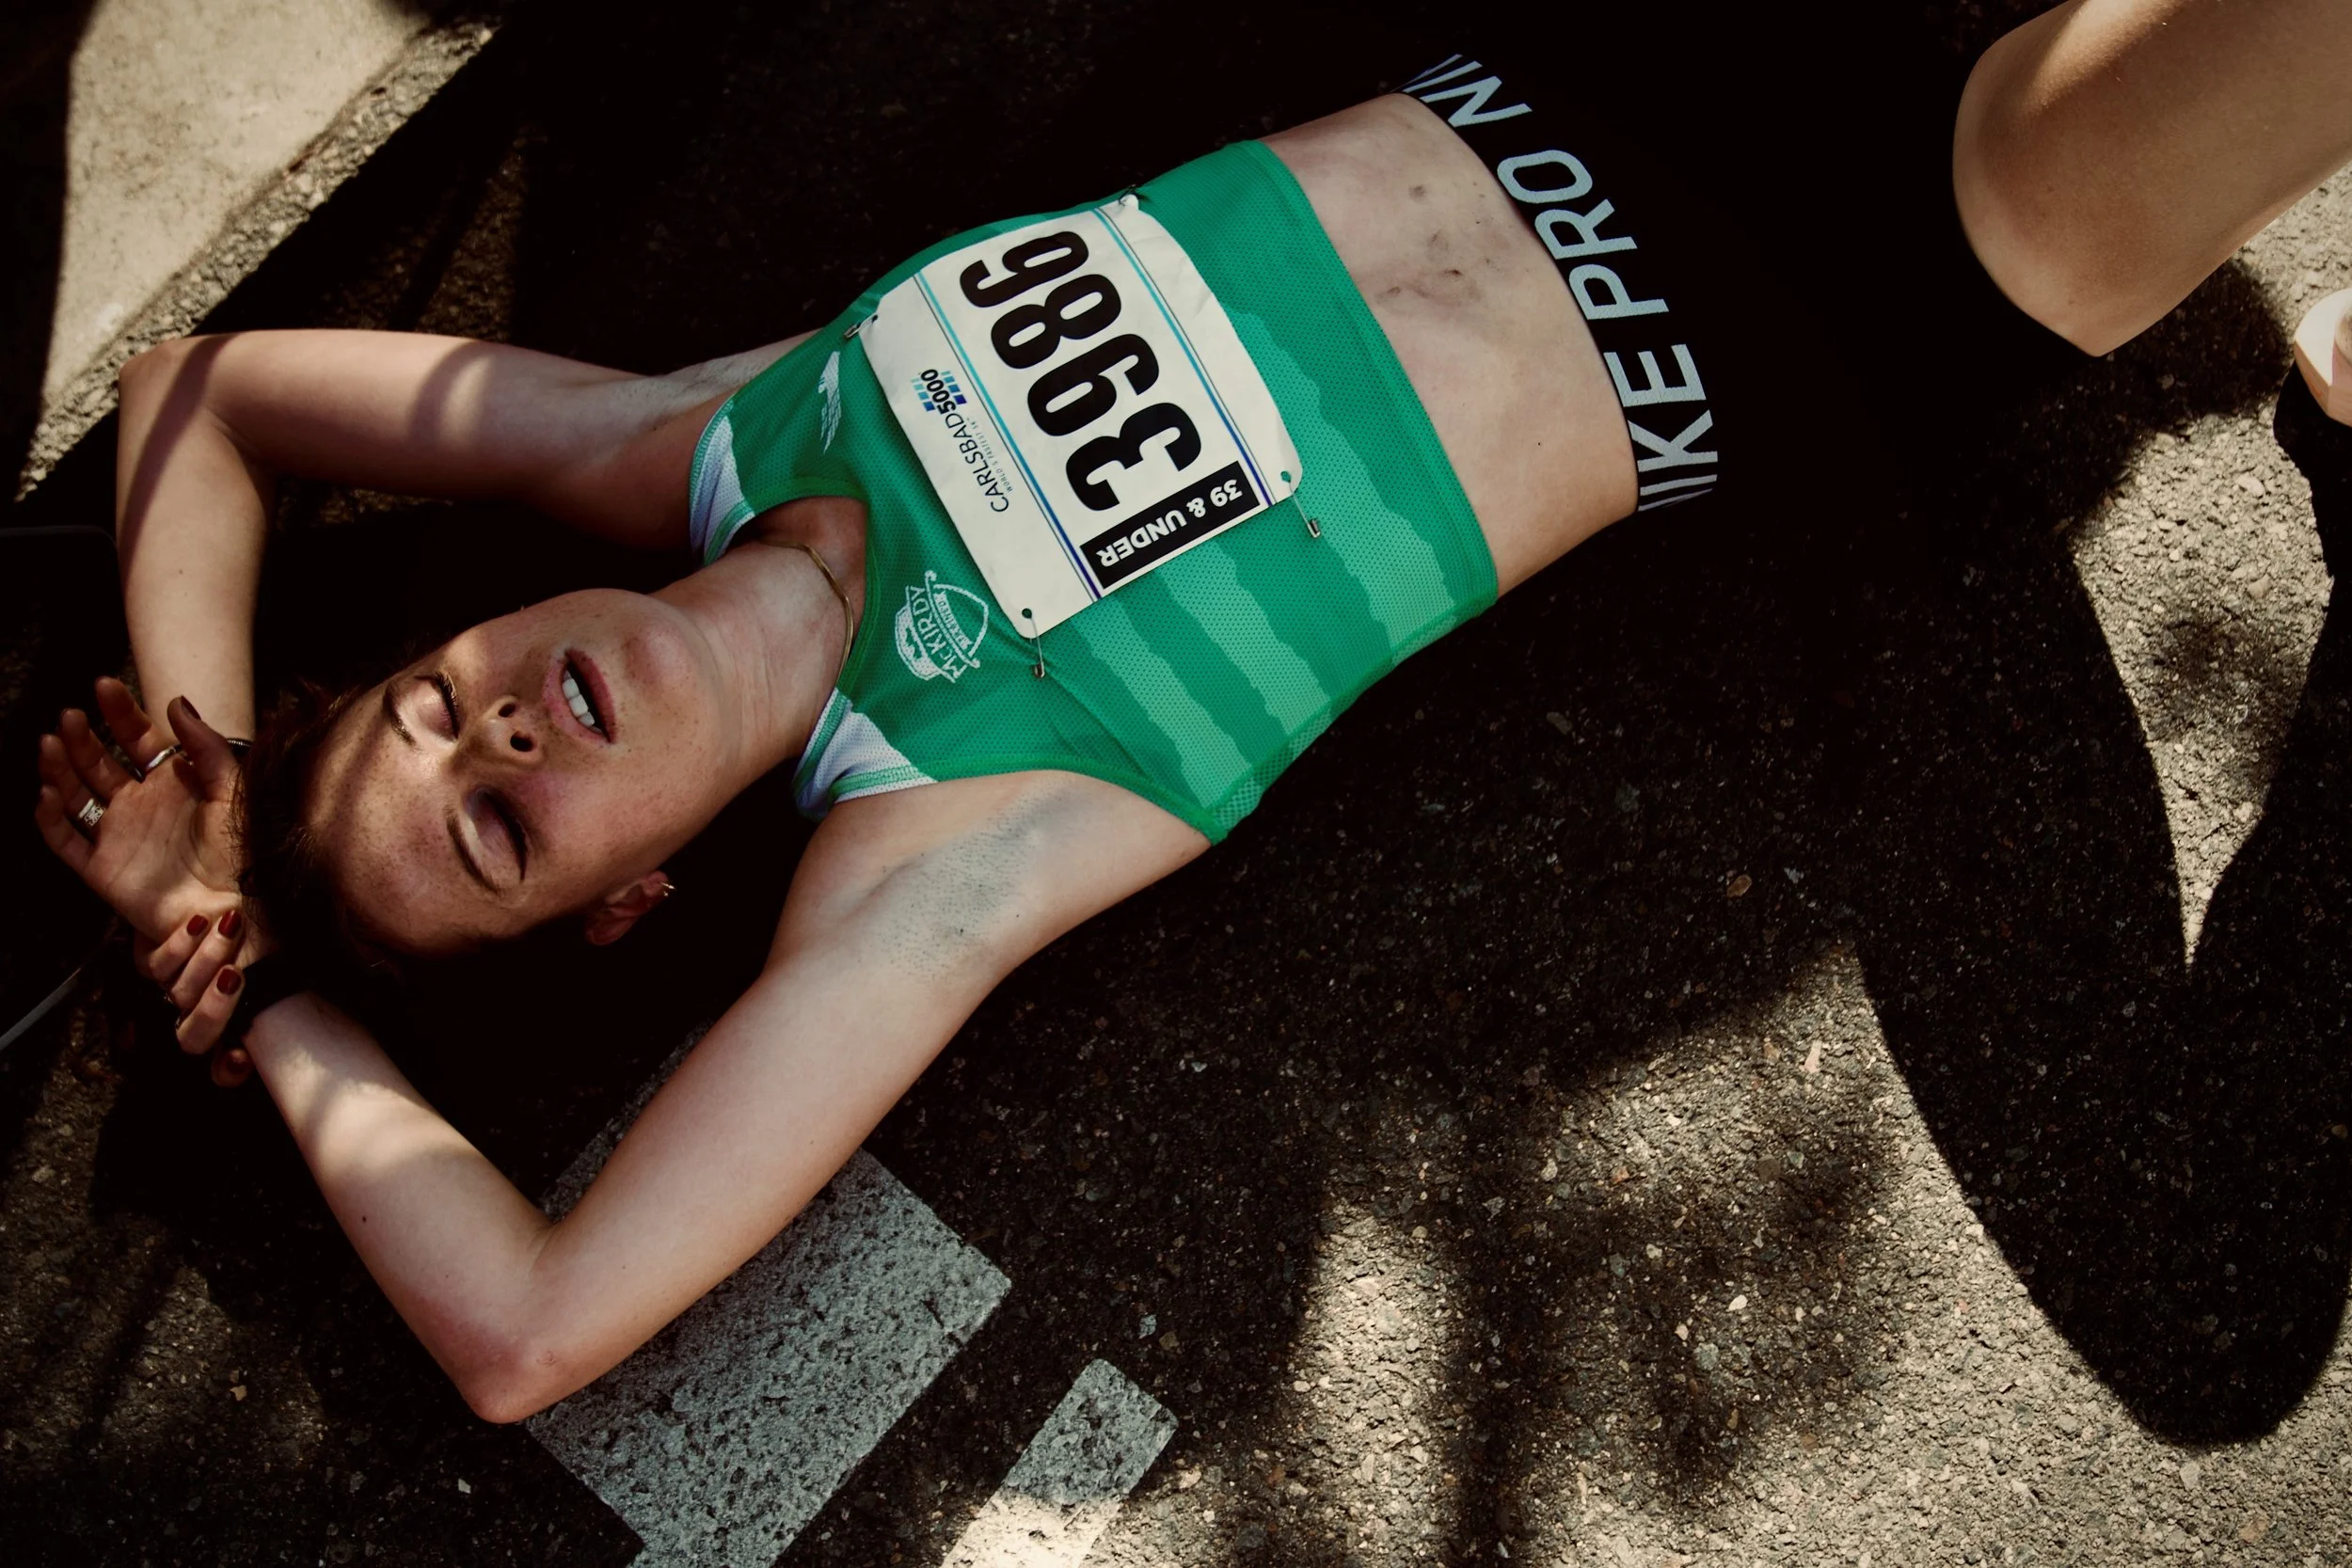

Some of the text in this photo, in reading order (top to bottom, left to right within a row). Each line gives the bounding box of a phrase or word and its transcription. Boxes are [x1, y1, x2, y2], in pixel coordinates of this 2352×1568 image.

[1497, 149, 1669, 321] PRO
[959, 230, 1202, 512] 3986
[1095, 479, 1243, 567] 39 & UNDER
